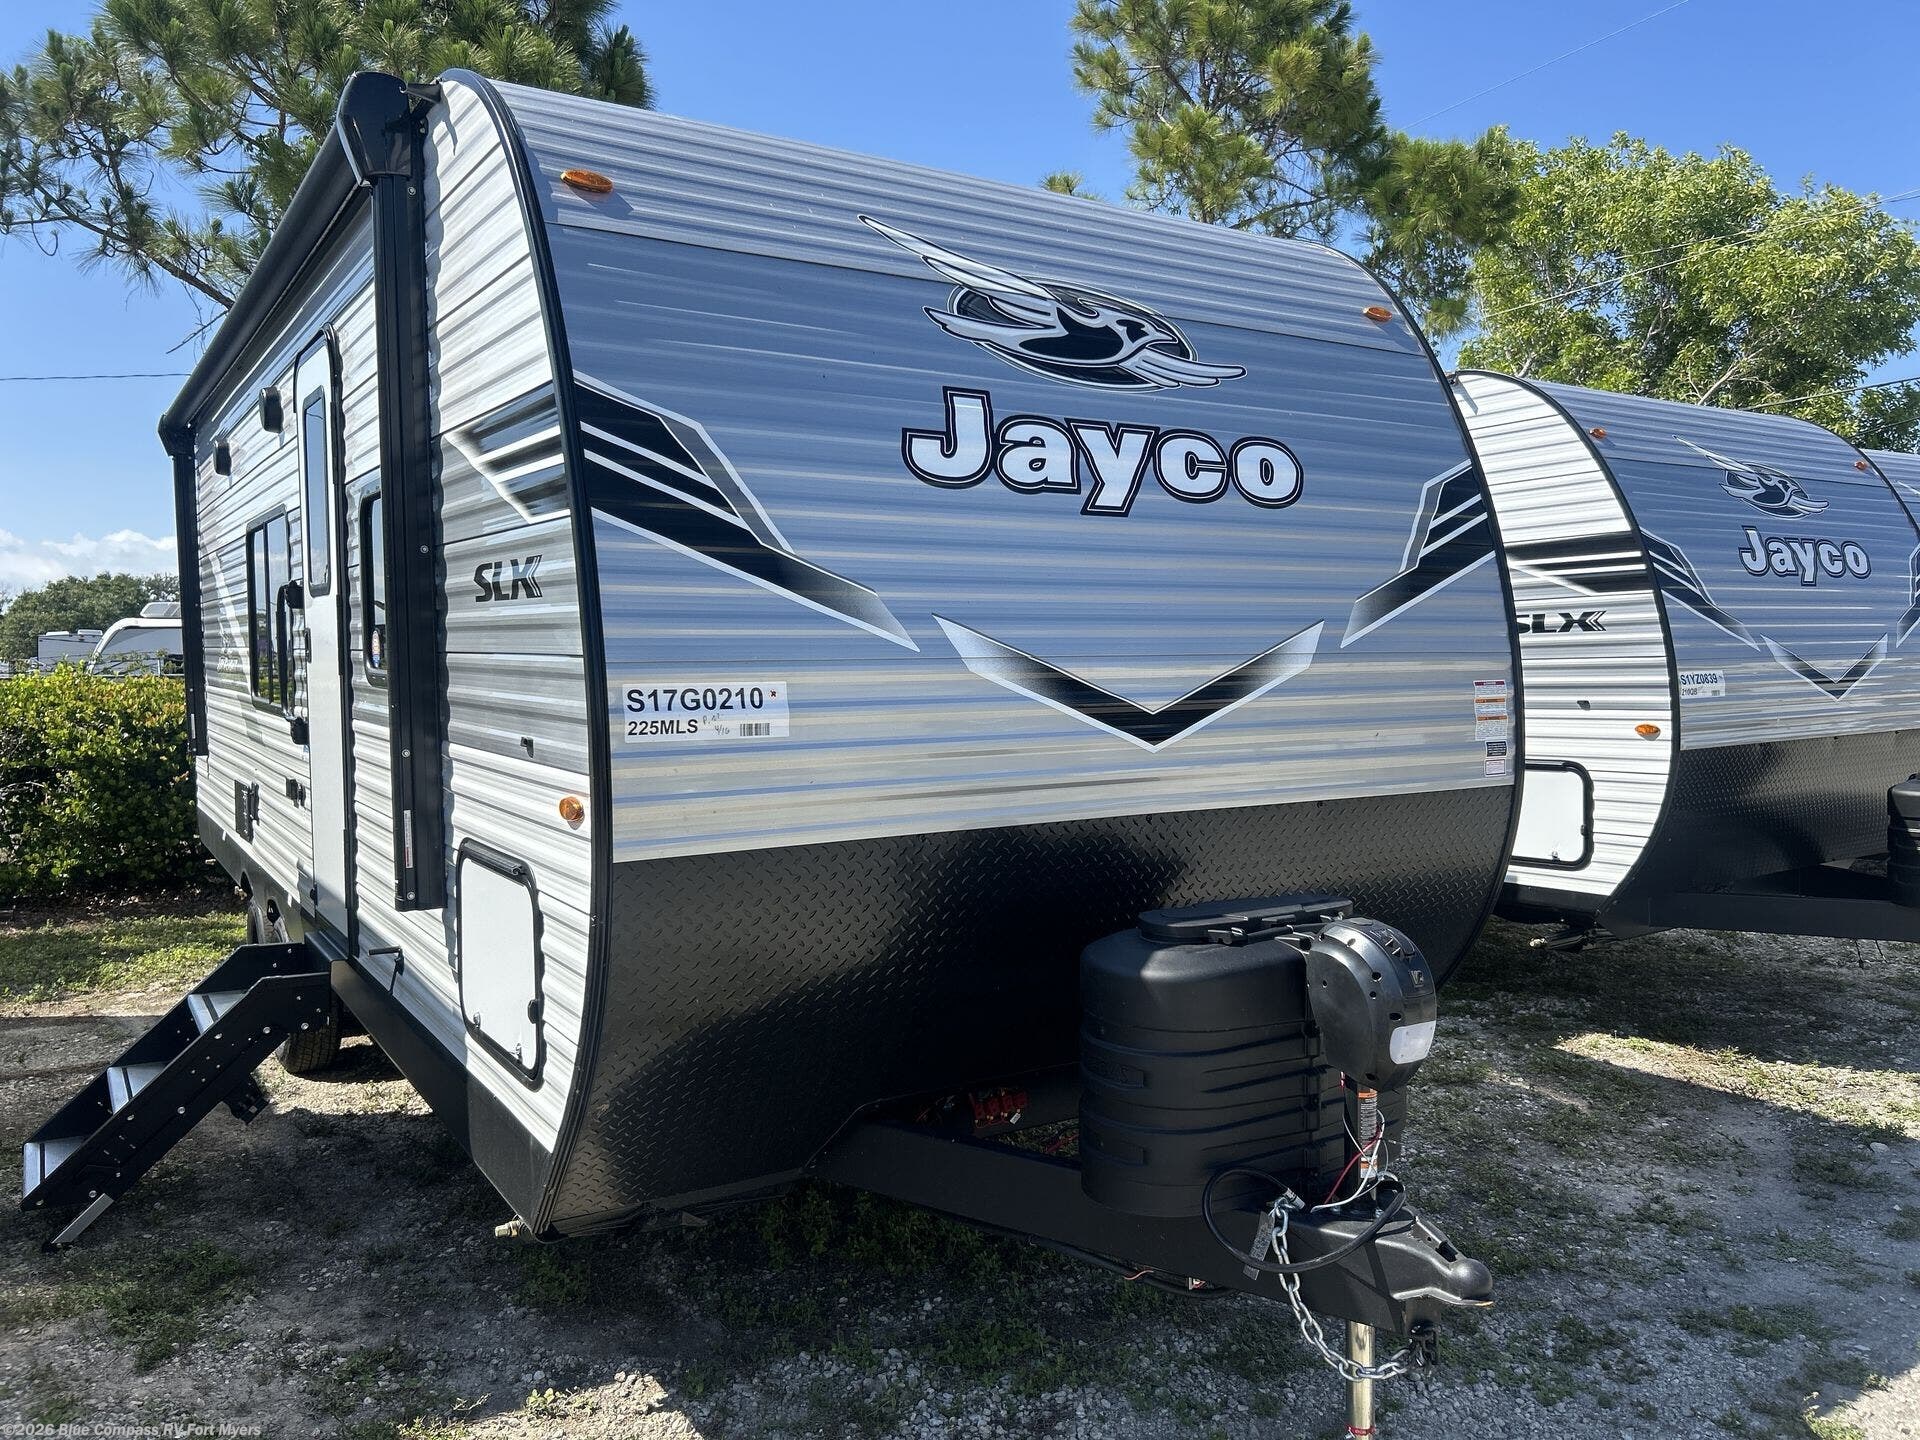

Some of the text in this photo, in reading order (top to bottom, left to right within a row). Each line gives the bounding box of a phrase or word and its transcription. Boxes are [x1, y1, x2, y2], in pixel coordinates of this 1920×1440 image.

[901, 386, 1304, 518] Jayco
[1738, 525, 1872, 587] Jayco
[1680, 673, 1718, 685] S1YZ0839
[627, 687, 764, 712] S17G0210
[628, 719, 698, 736] 225MLS
